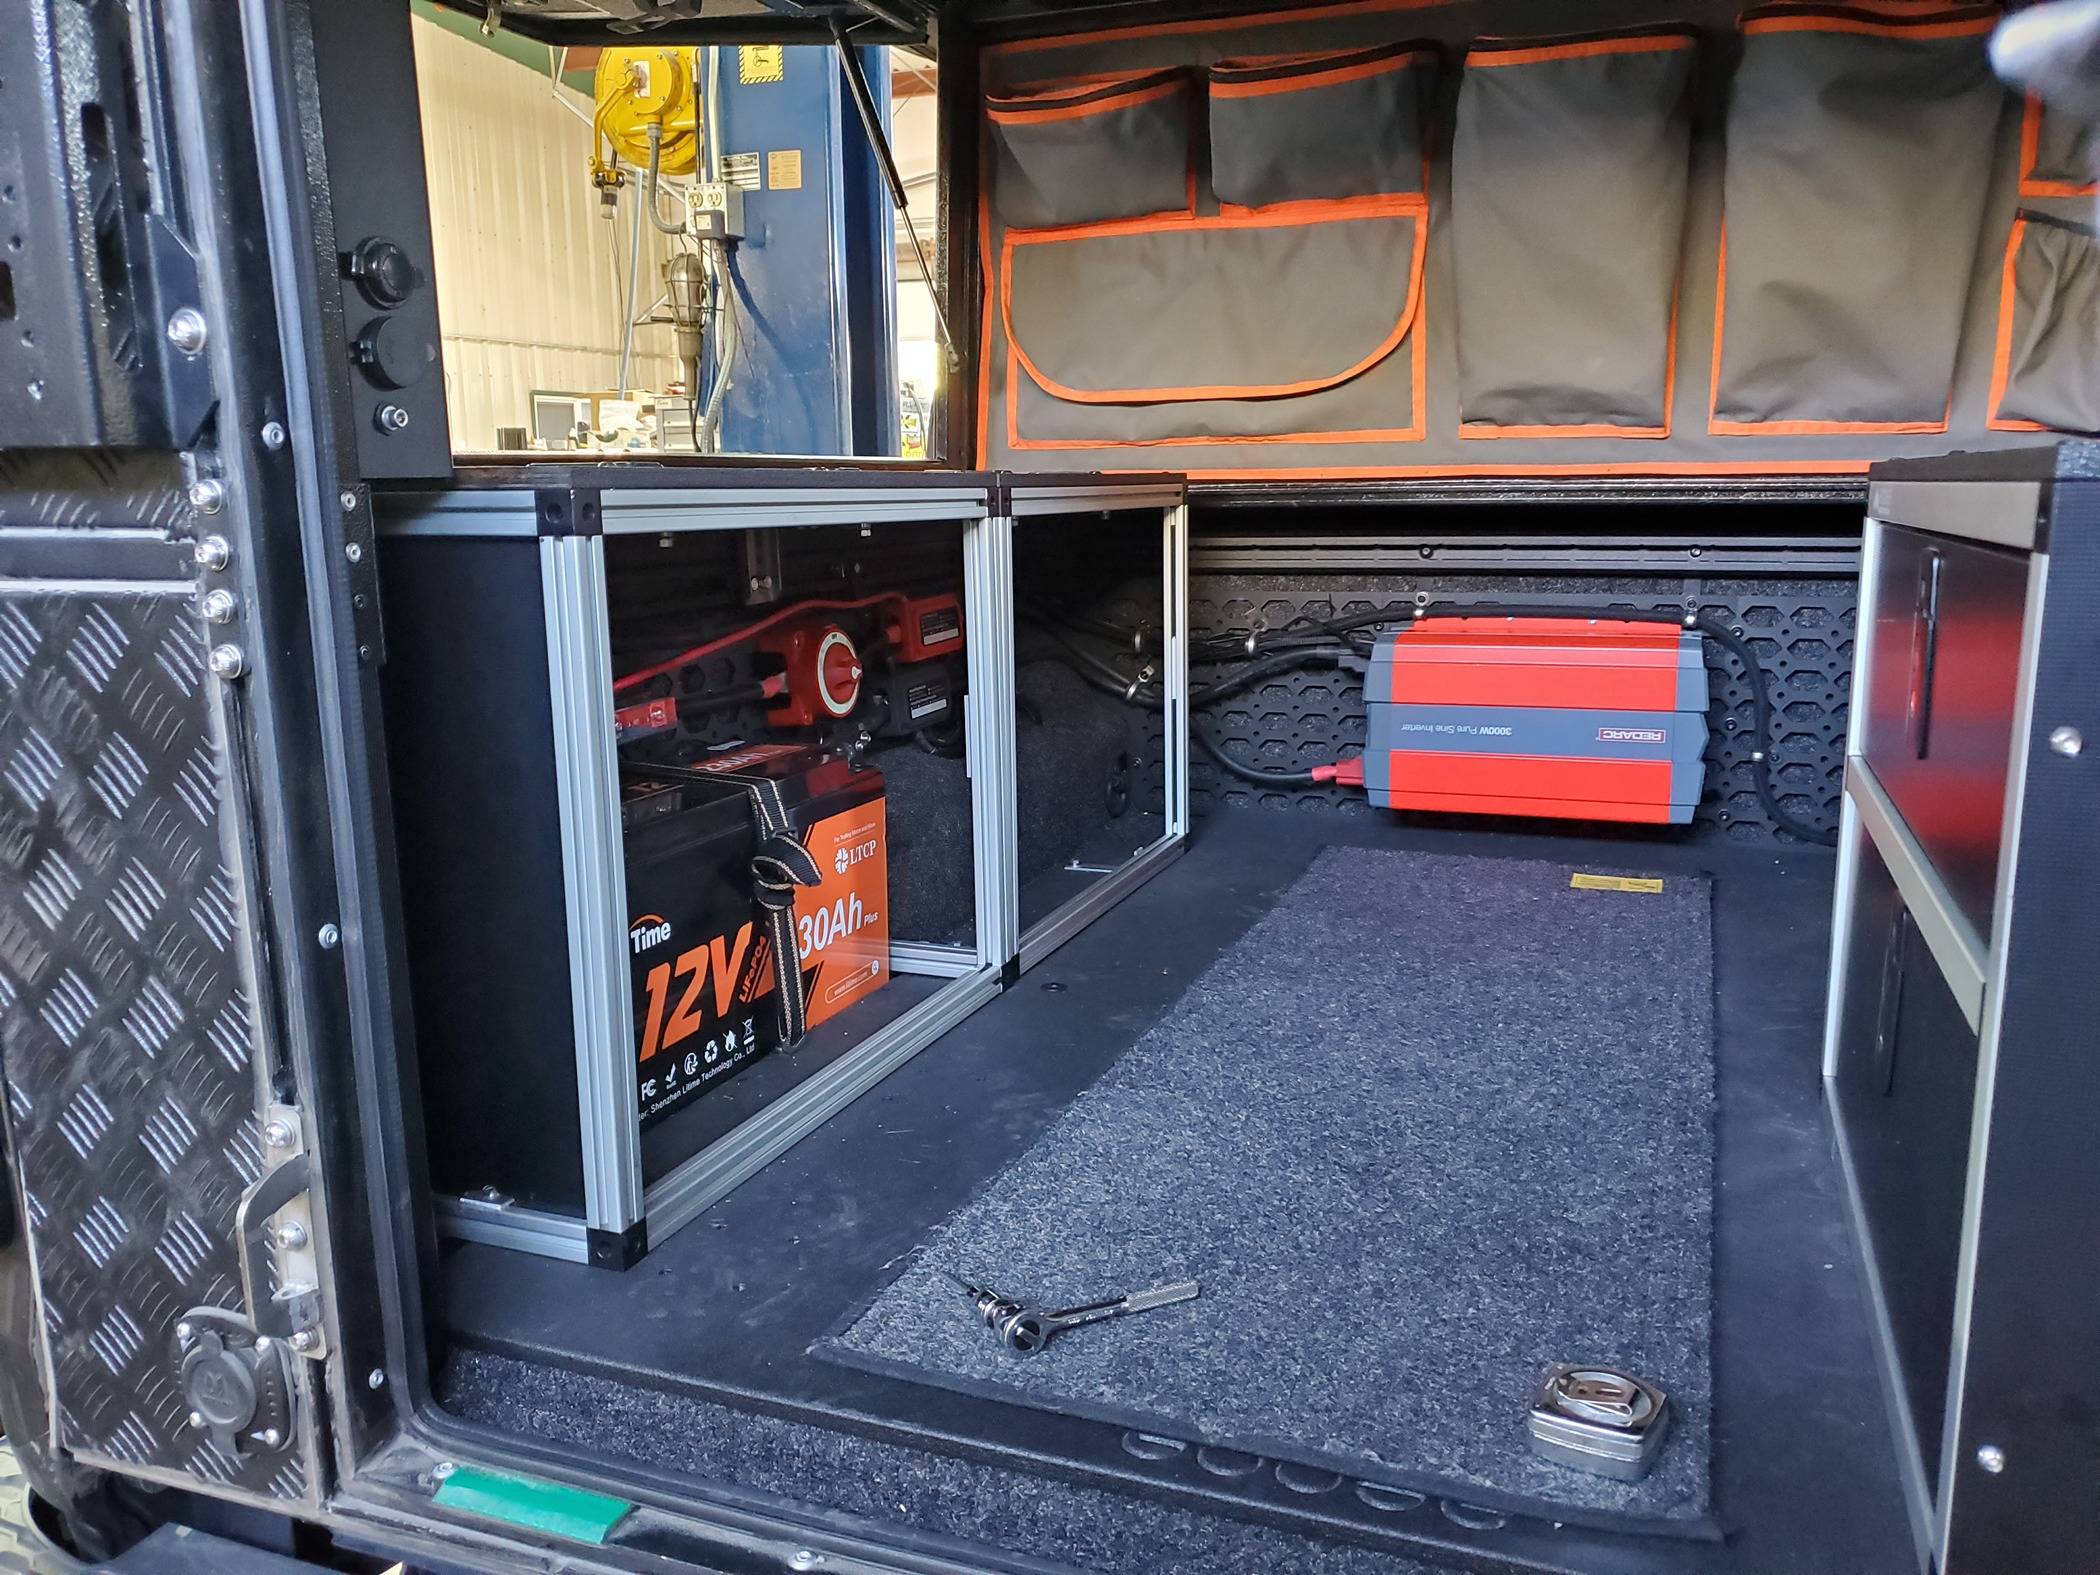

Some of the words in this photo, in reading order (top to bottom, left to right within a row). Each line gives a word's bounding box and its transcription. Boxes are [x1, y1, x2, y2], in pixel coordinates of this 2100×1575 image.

[1401, 723, 1433, 734] Inverter
[1435, 723, 1456, 735] Sine
[1457, 724, 1478, 736] Pure
[1479, 725, 1513, 737] 3000W
[1602, 730, 1662, 741] REDARC
[849, 839, 876, 866] LTCP
[864, 912, 878, 926] Plus
[639, 921, 753, 1063] 12V
[651, 1091, 681, 1113] Shenzhen
[701, 1059, 733, 1081] Technology
